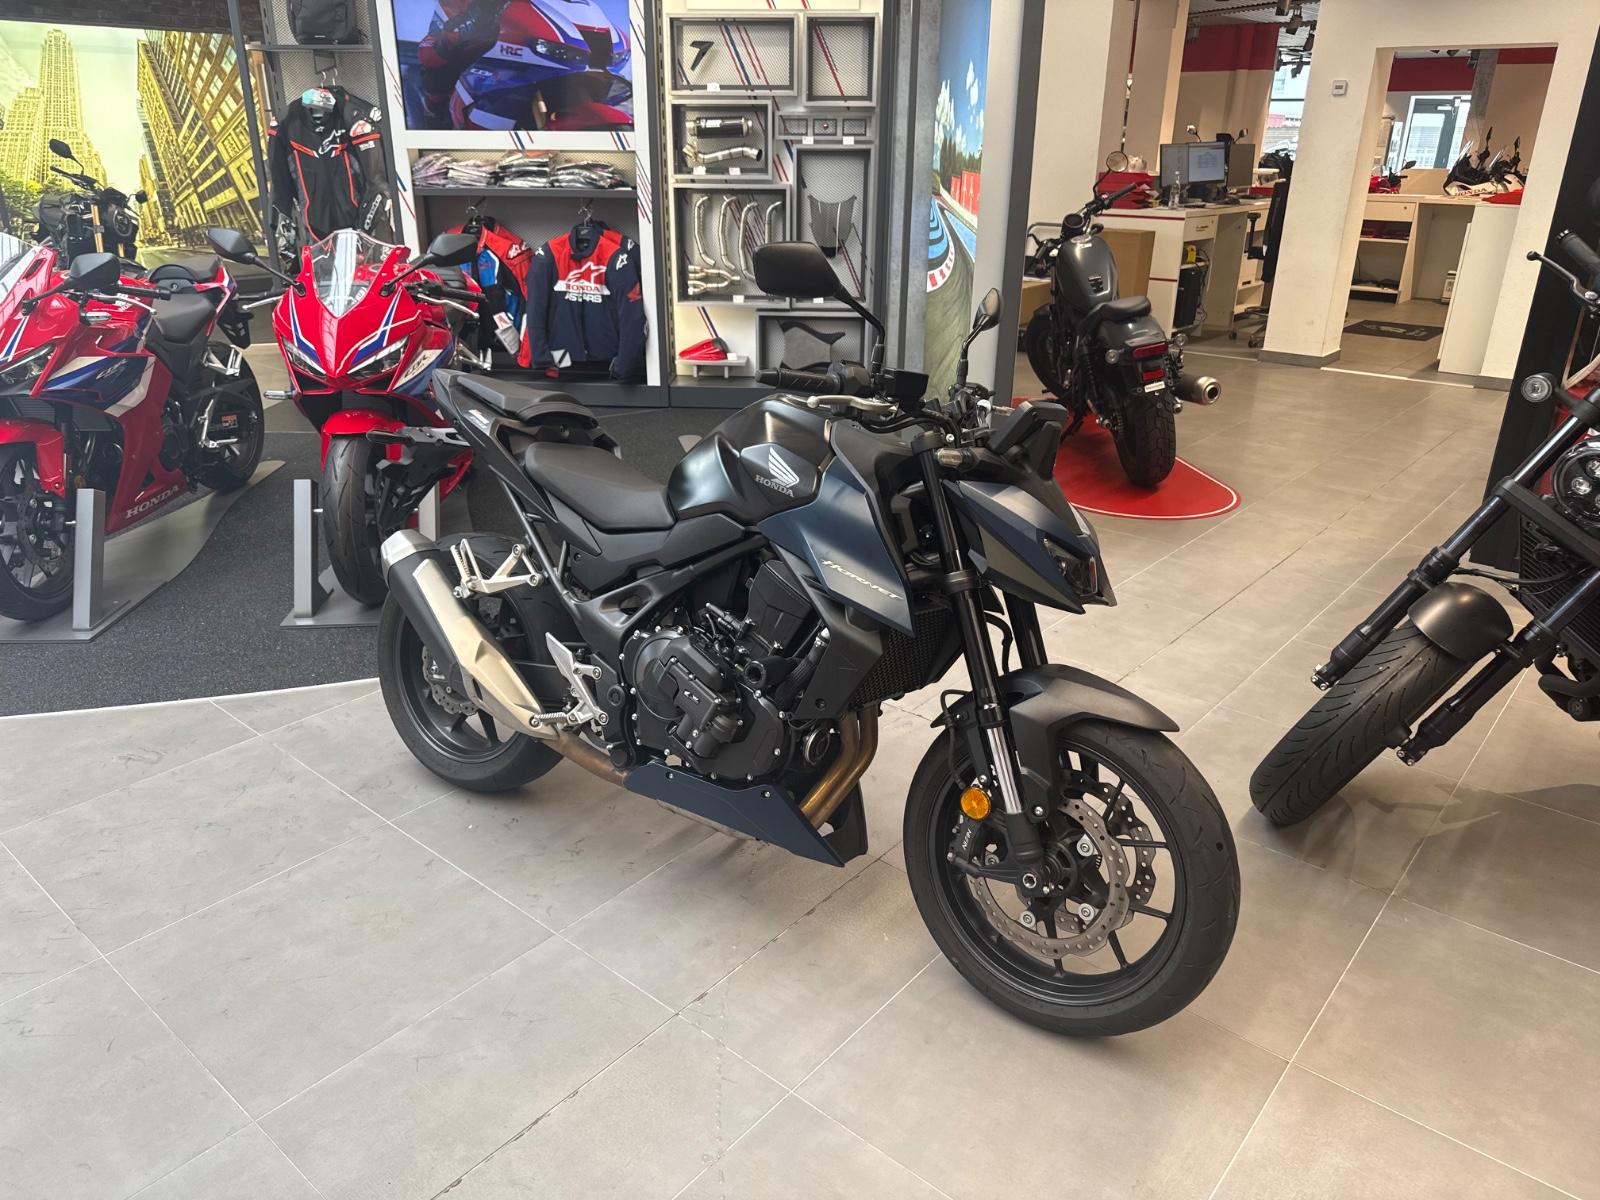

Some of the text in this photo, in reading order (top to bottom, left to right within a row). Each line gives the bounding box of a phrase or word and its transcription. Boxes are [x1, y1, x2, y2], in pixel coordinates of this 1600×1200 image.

[500, 44, 524, 57] HRC
[565, 283, 602, 293] HONDA
[755, 475, 795, 498] HONDA
[126, 485, 180, 519] HONDA
